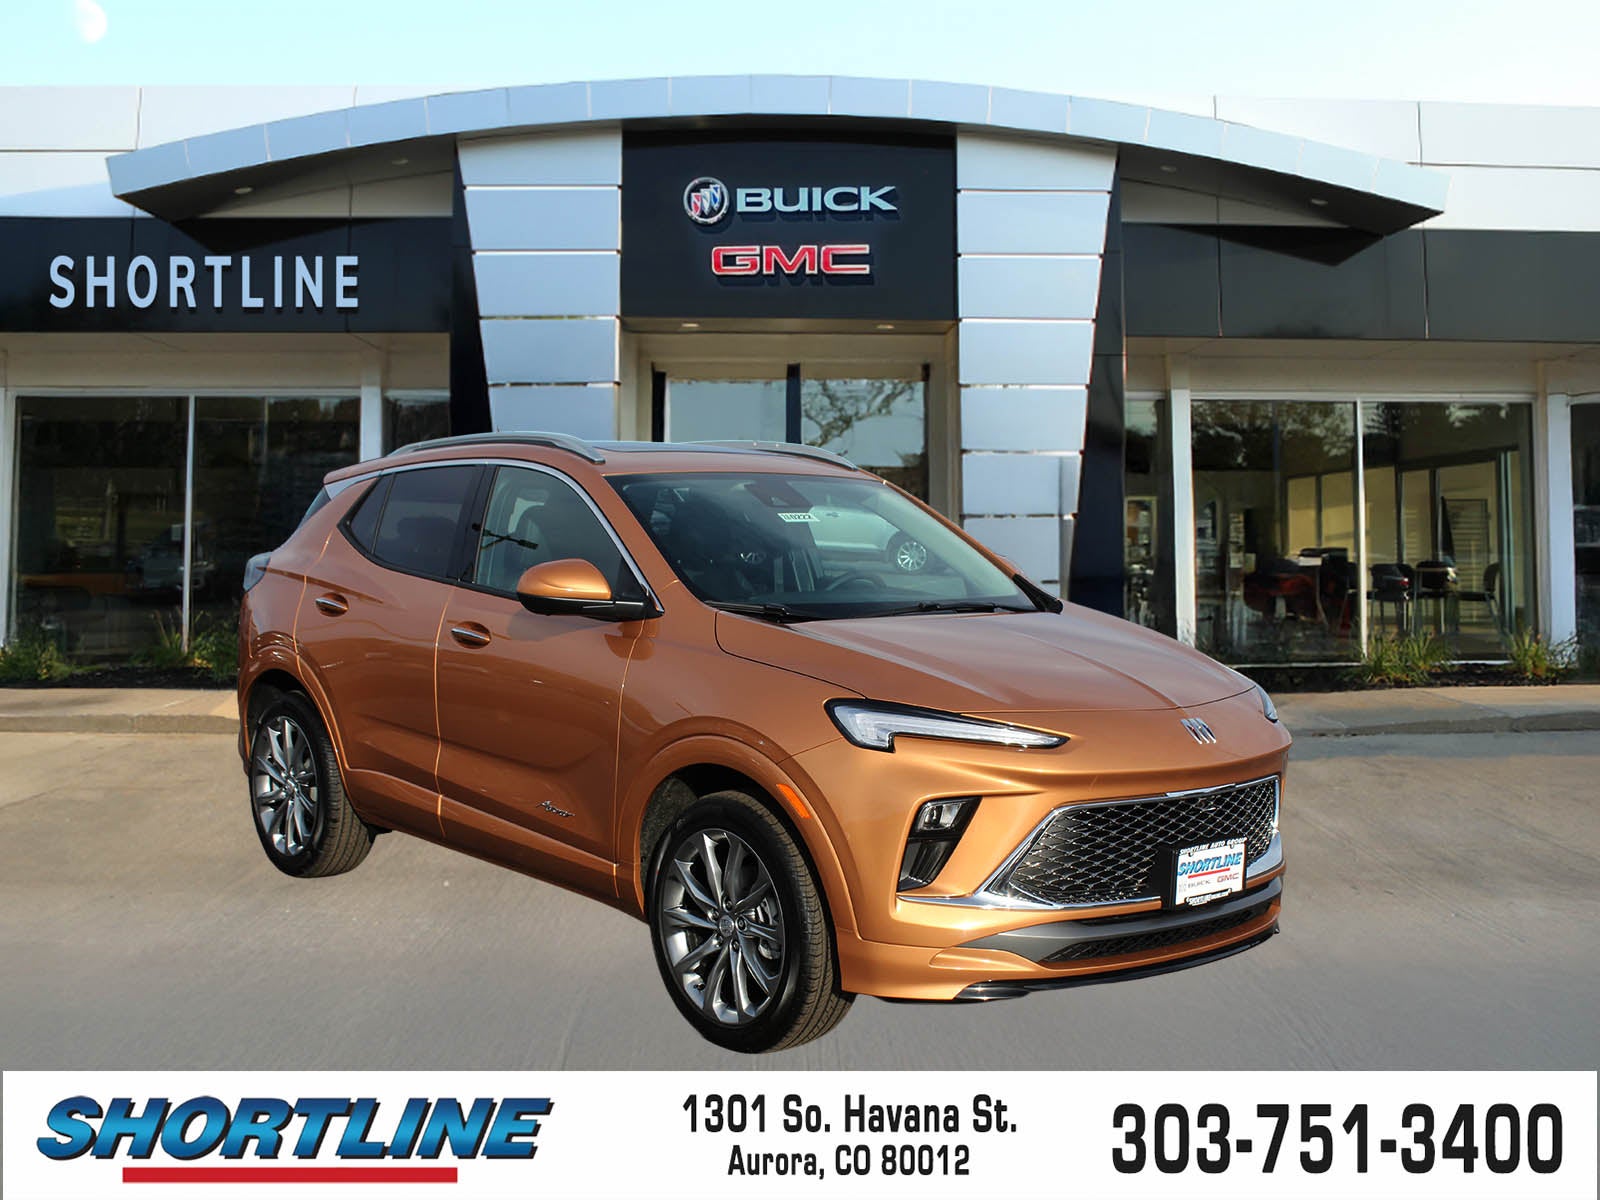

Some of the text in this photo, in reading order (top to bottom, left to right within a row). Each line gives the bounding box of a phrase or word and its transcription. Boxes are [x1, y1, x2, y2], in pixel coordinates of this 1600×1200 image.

[736, 185, 898, 213] BUICK
[711, 244, 870, 276] GMC
[49, 254, 360, 309] SHORTLINE
[1177, 851, 1243, 876] SHORTLINE
[1216, 872, 1240, 883] GMC
